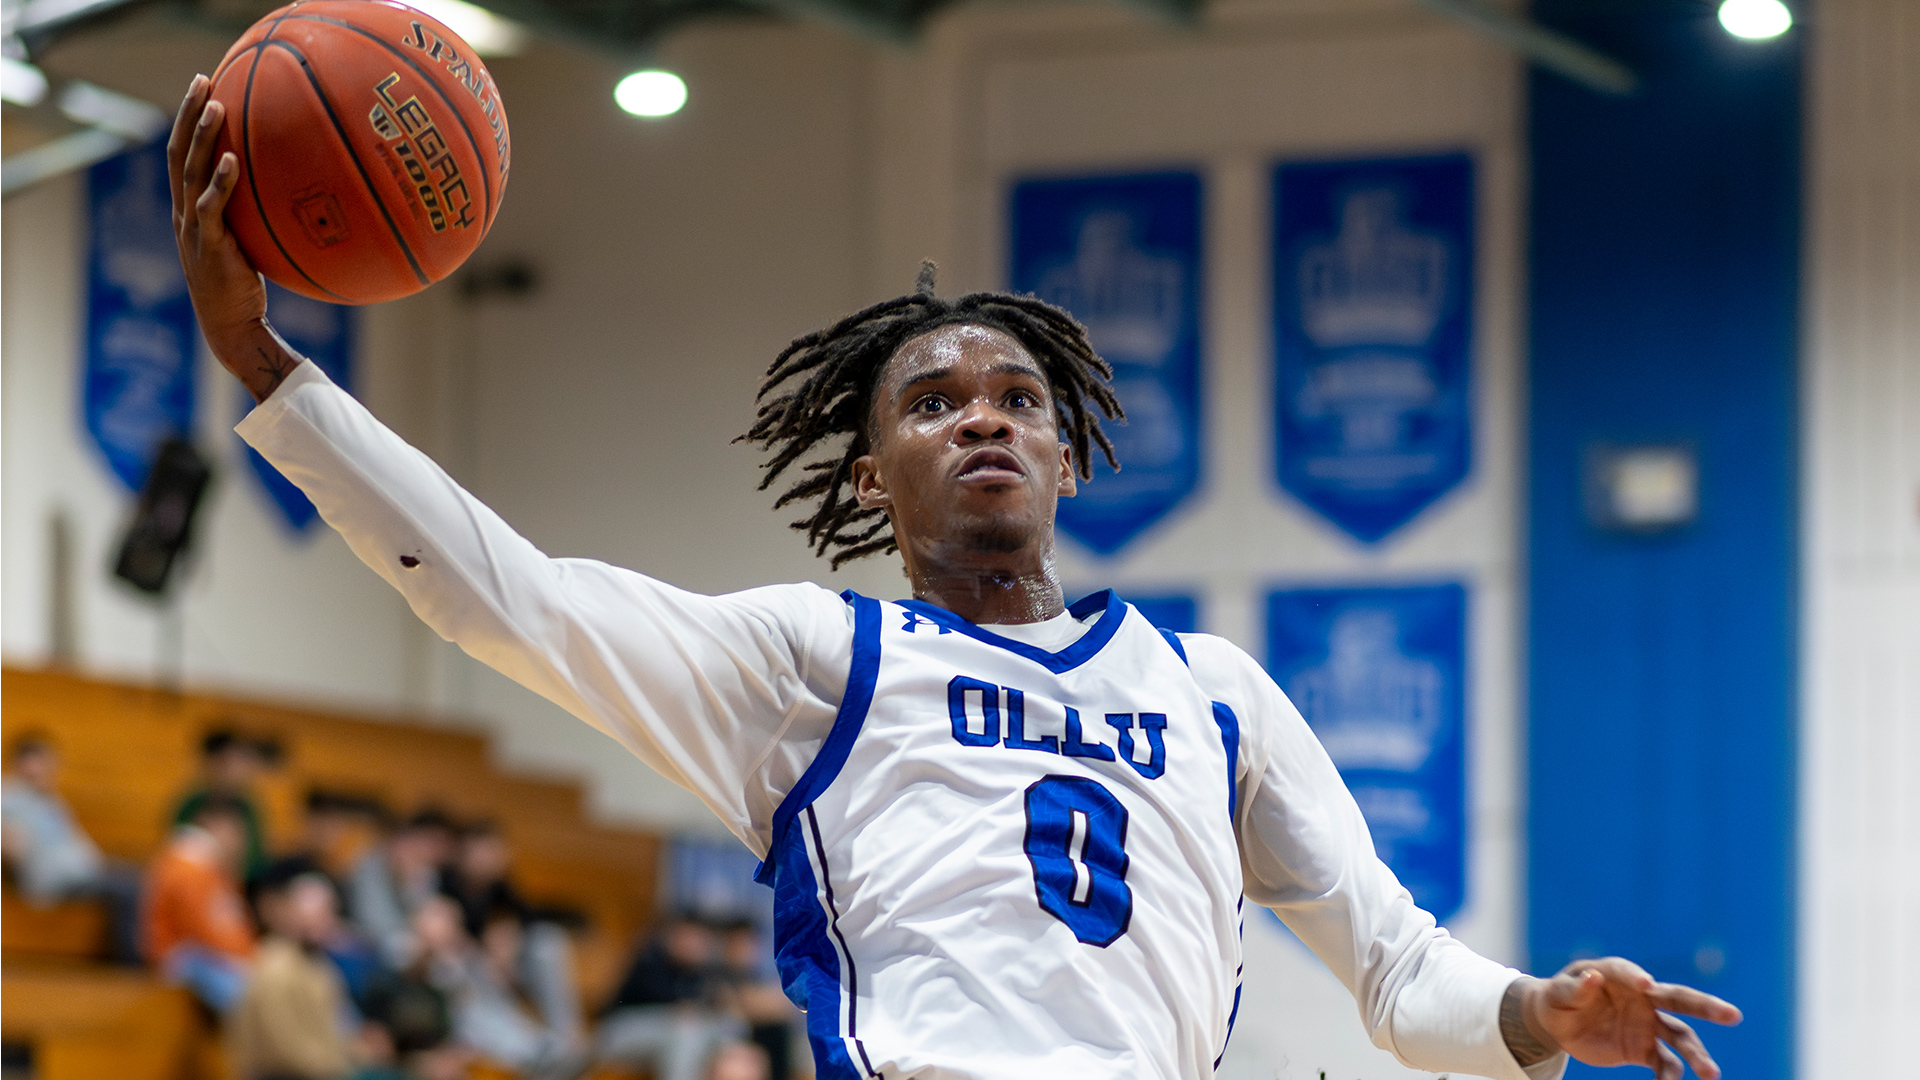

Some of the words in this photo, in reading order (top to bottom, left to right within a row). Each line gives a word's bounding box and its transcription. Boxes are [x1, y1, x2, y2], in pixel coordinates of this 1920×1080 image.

[373, 71, 475, 229] LEGACY
[402, 20, 508, 174] SPALDIN
[393, 140, 447, 233] 1000
[947, 675, 1167, 779] OLLU
[1023, 774, 1133, 948] 0
